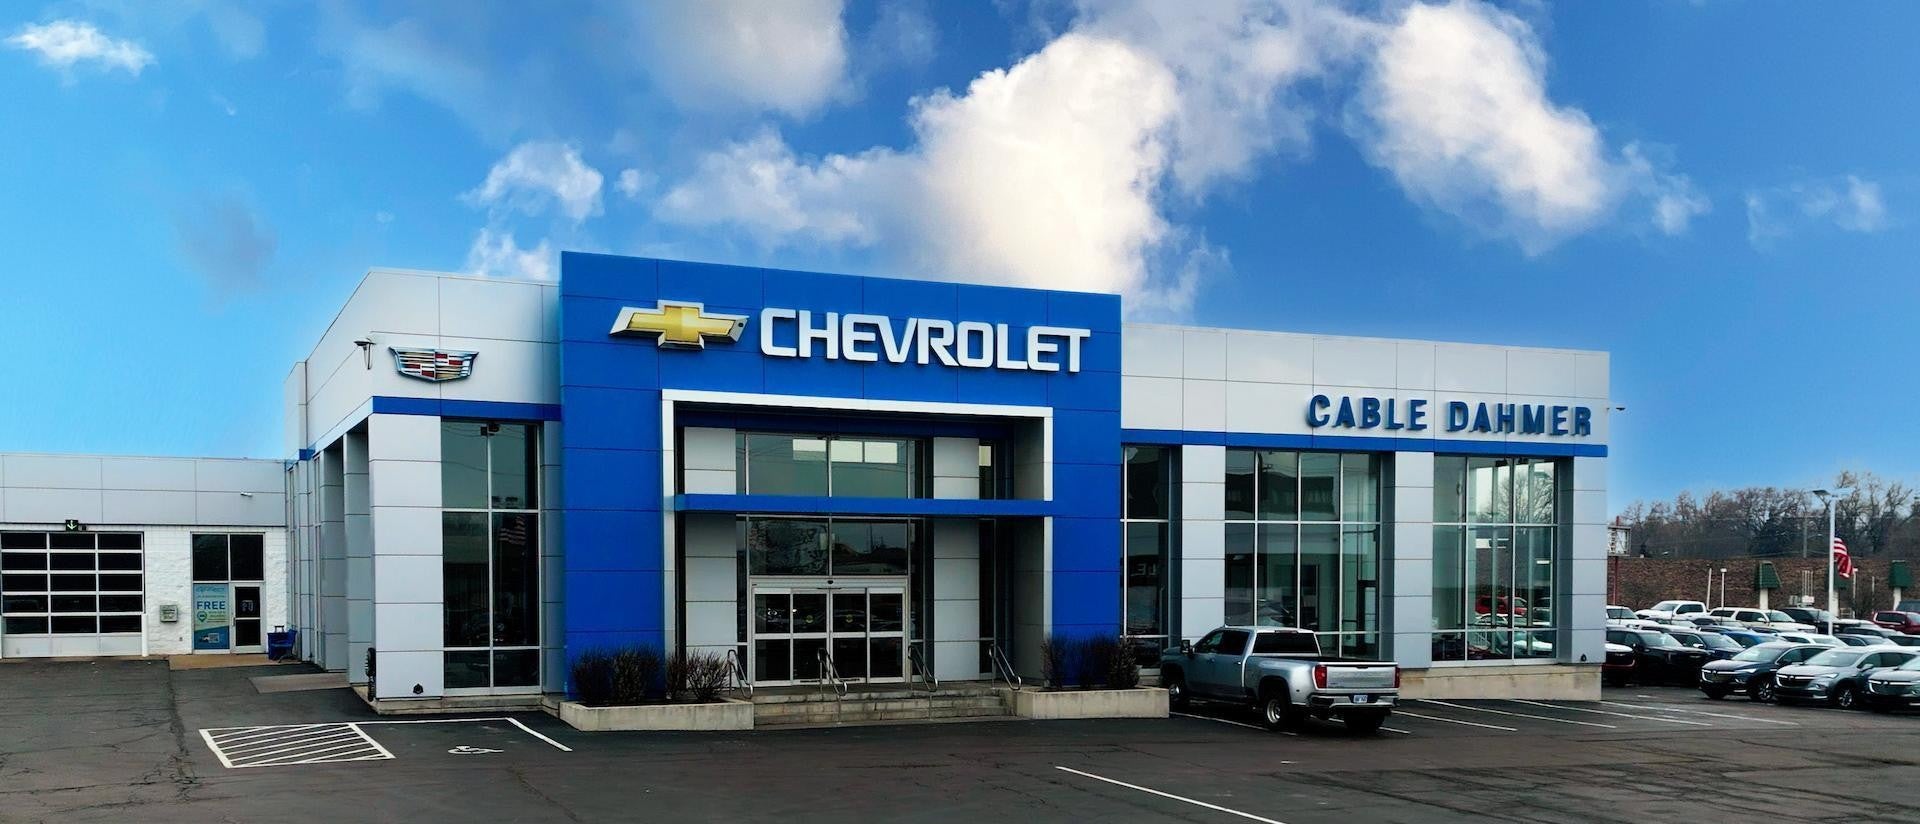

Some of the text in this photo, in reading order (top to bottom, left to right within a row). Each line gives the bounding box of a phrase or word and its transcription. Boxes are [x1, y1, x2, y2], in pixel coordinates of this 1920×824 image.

[760, 307, 1091, 373] CHEVROLET
[1306, 394, 1591, 436] CABLE DAHMER
[196, 600, 226, 610] FREE
